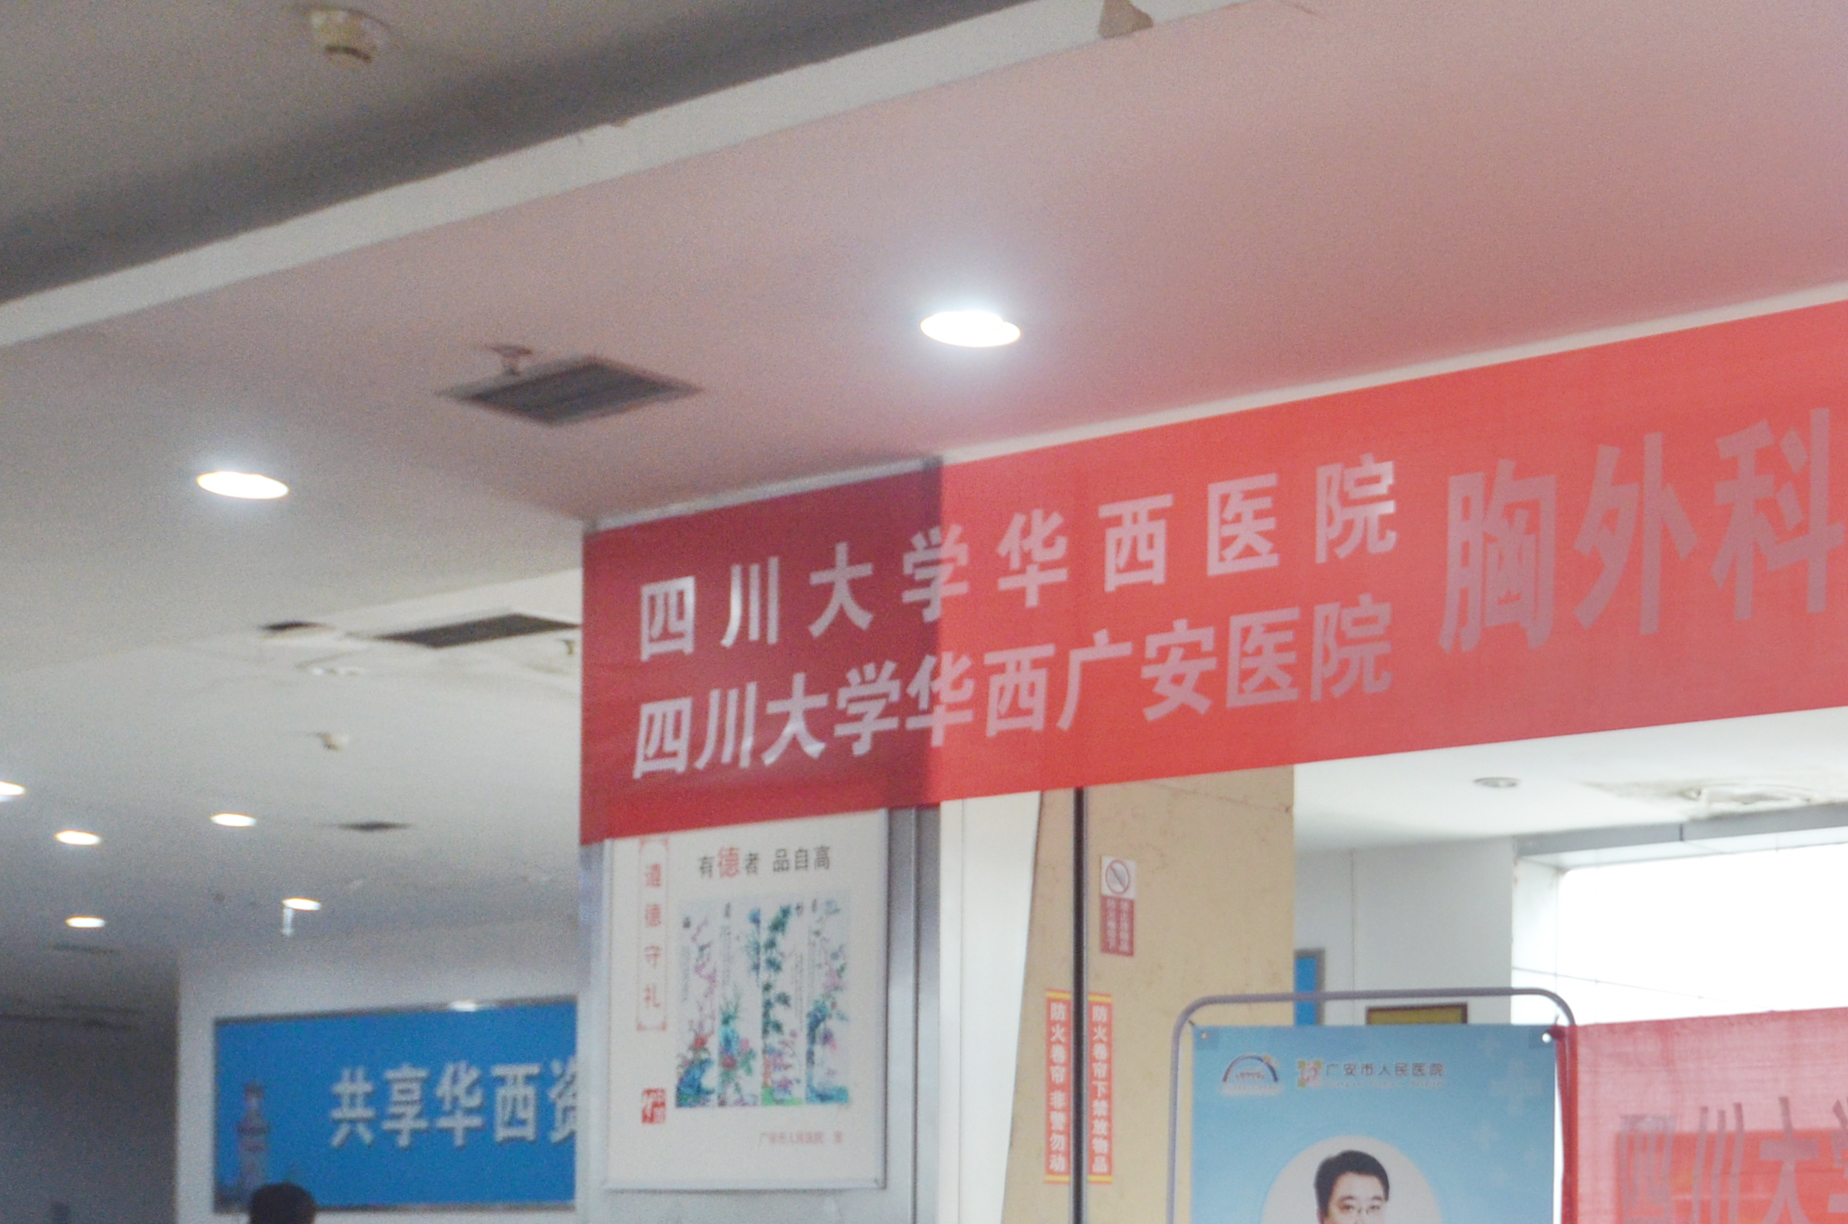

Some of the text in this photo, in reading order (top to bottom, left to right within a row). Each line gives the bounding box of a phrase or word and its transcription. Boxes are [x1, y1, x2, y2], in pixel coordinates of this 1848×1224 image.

[638, 452, 1399, 662] 四川大学华西医院
[1438, 406, 1846, 655] 胸外科
[631, 594, 1395, 780] 四川大学华西广安医院
[697, 844, 832, 879] 有德者 品自高
